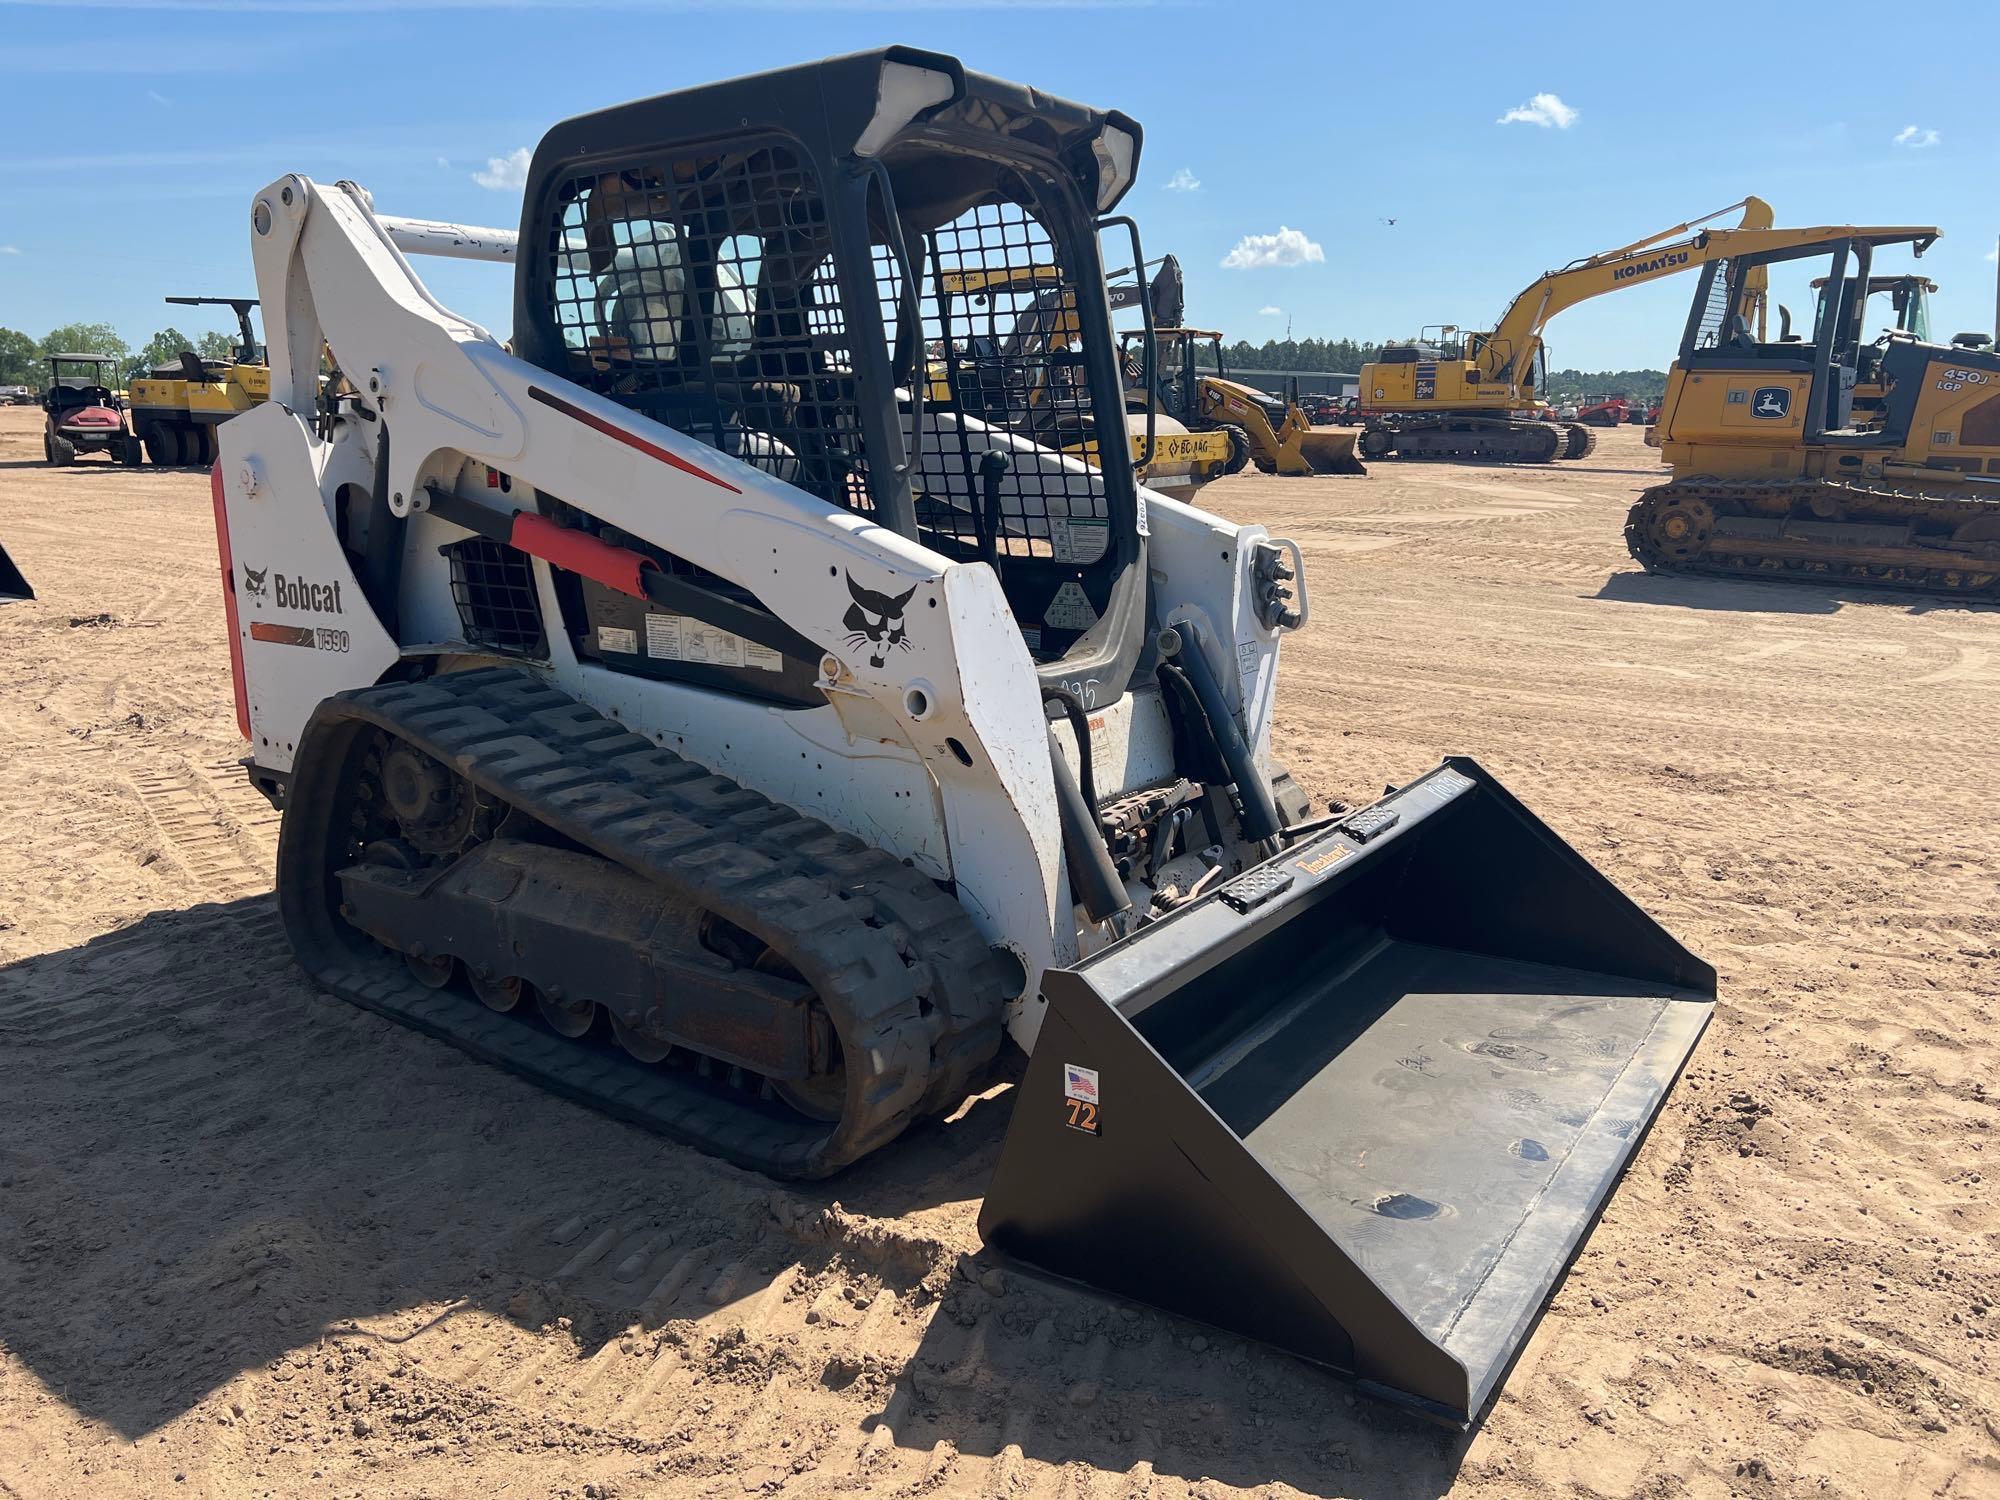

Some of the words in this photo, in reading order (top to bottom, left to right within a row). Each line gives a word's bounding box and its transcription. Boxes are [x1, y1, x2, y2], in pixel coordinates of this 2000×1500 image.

[1614, 251, 1688, 280] KOMATSU
[1937, 380, 1962, 392] LGP
[1944, 368, 1989, 385] 450J
[1416, 386, 1433, 394] 290
[274, 573, 343, 614] Bobcat
[316, 627, 350, 653] T590
[1066, 1098, 1097, 1130] 72
